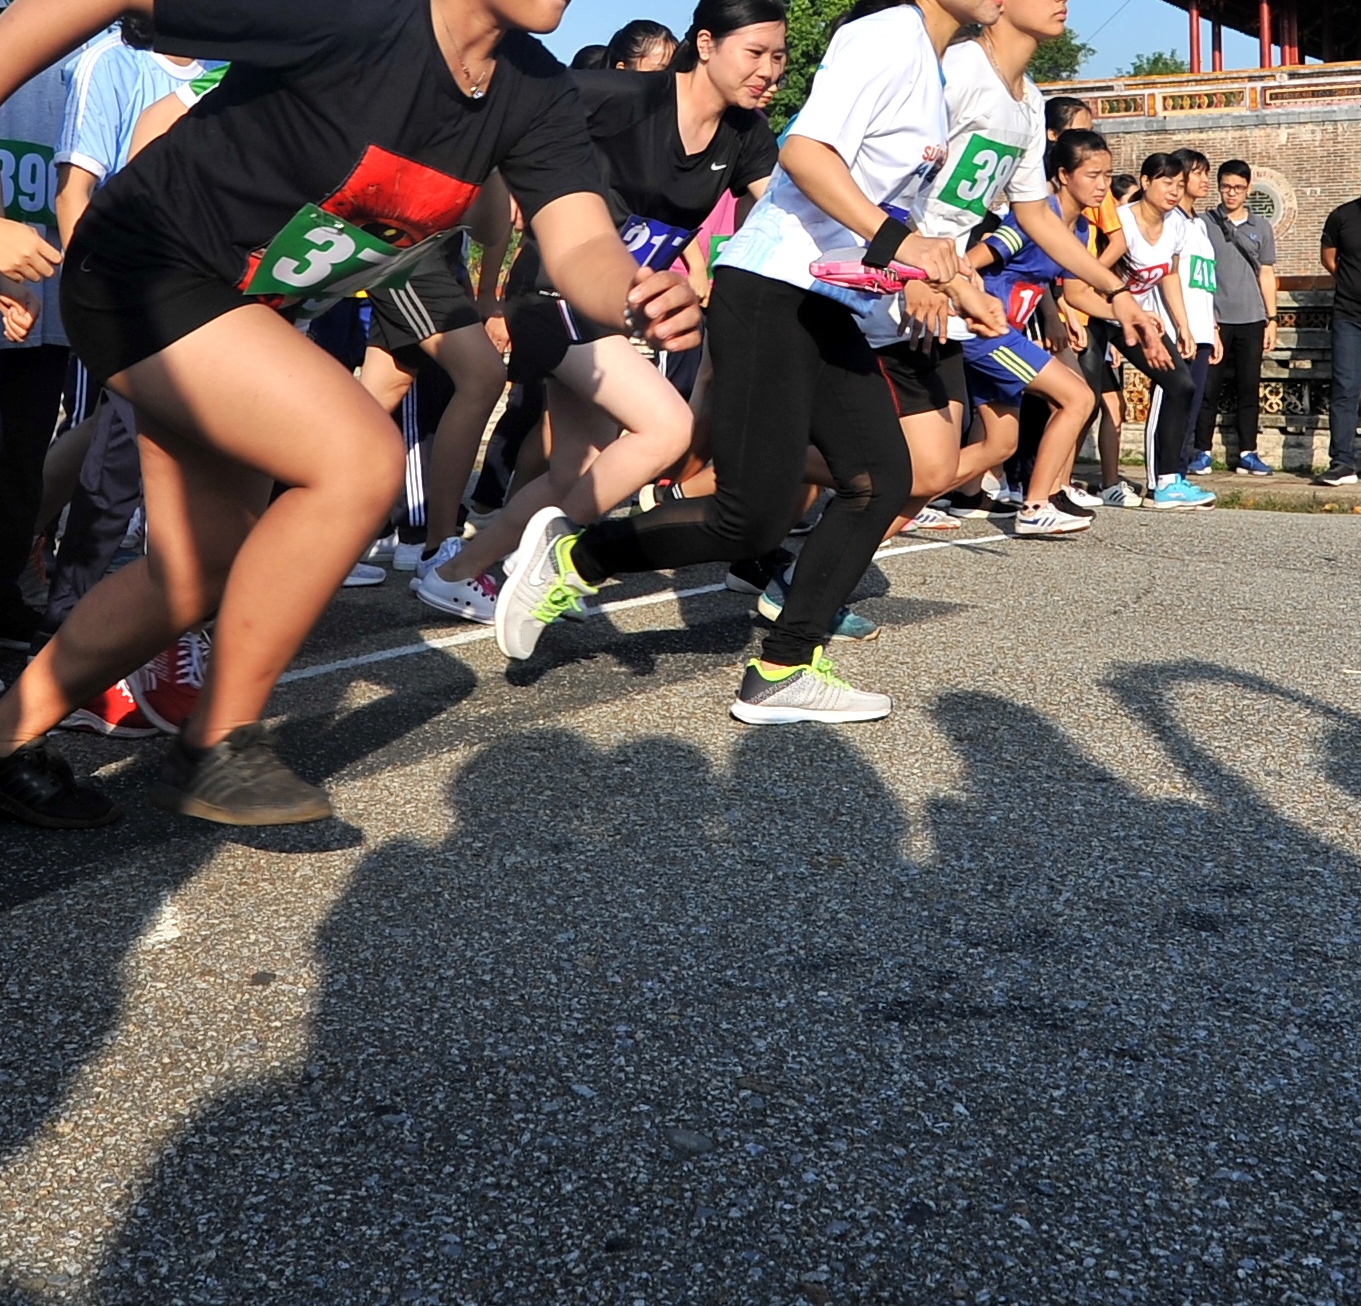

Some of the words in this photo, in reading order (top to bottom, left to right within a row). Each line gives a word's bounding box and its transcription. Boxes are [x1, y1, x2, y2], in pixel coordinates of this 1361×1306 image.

[957, 149, 1020, 209] 38
[623, 224, 684, 267] 21
[1016, 289, 1042, 325] 1
